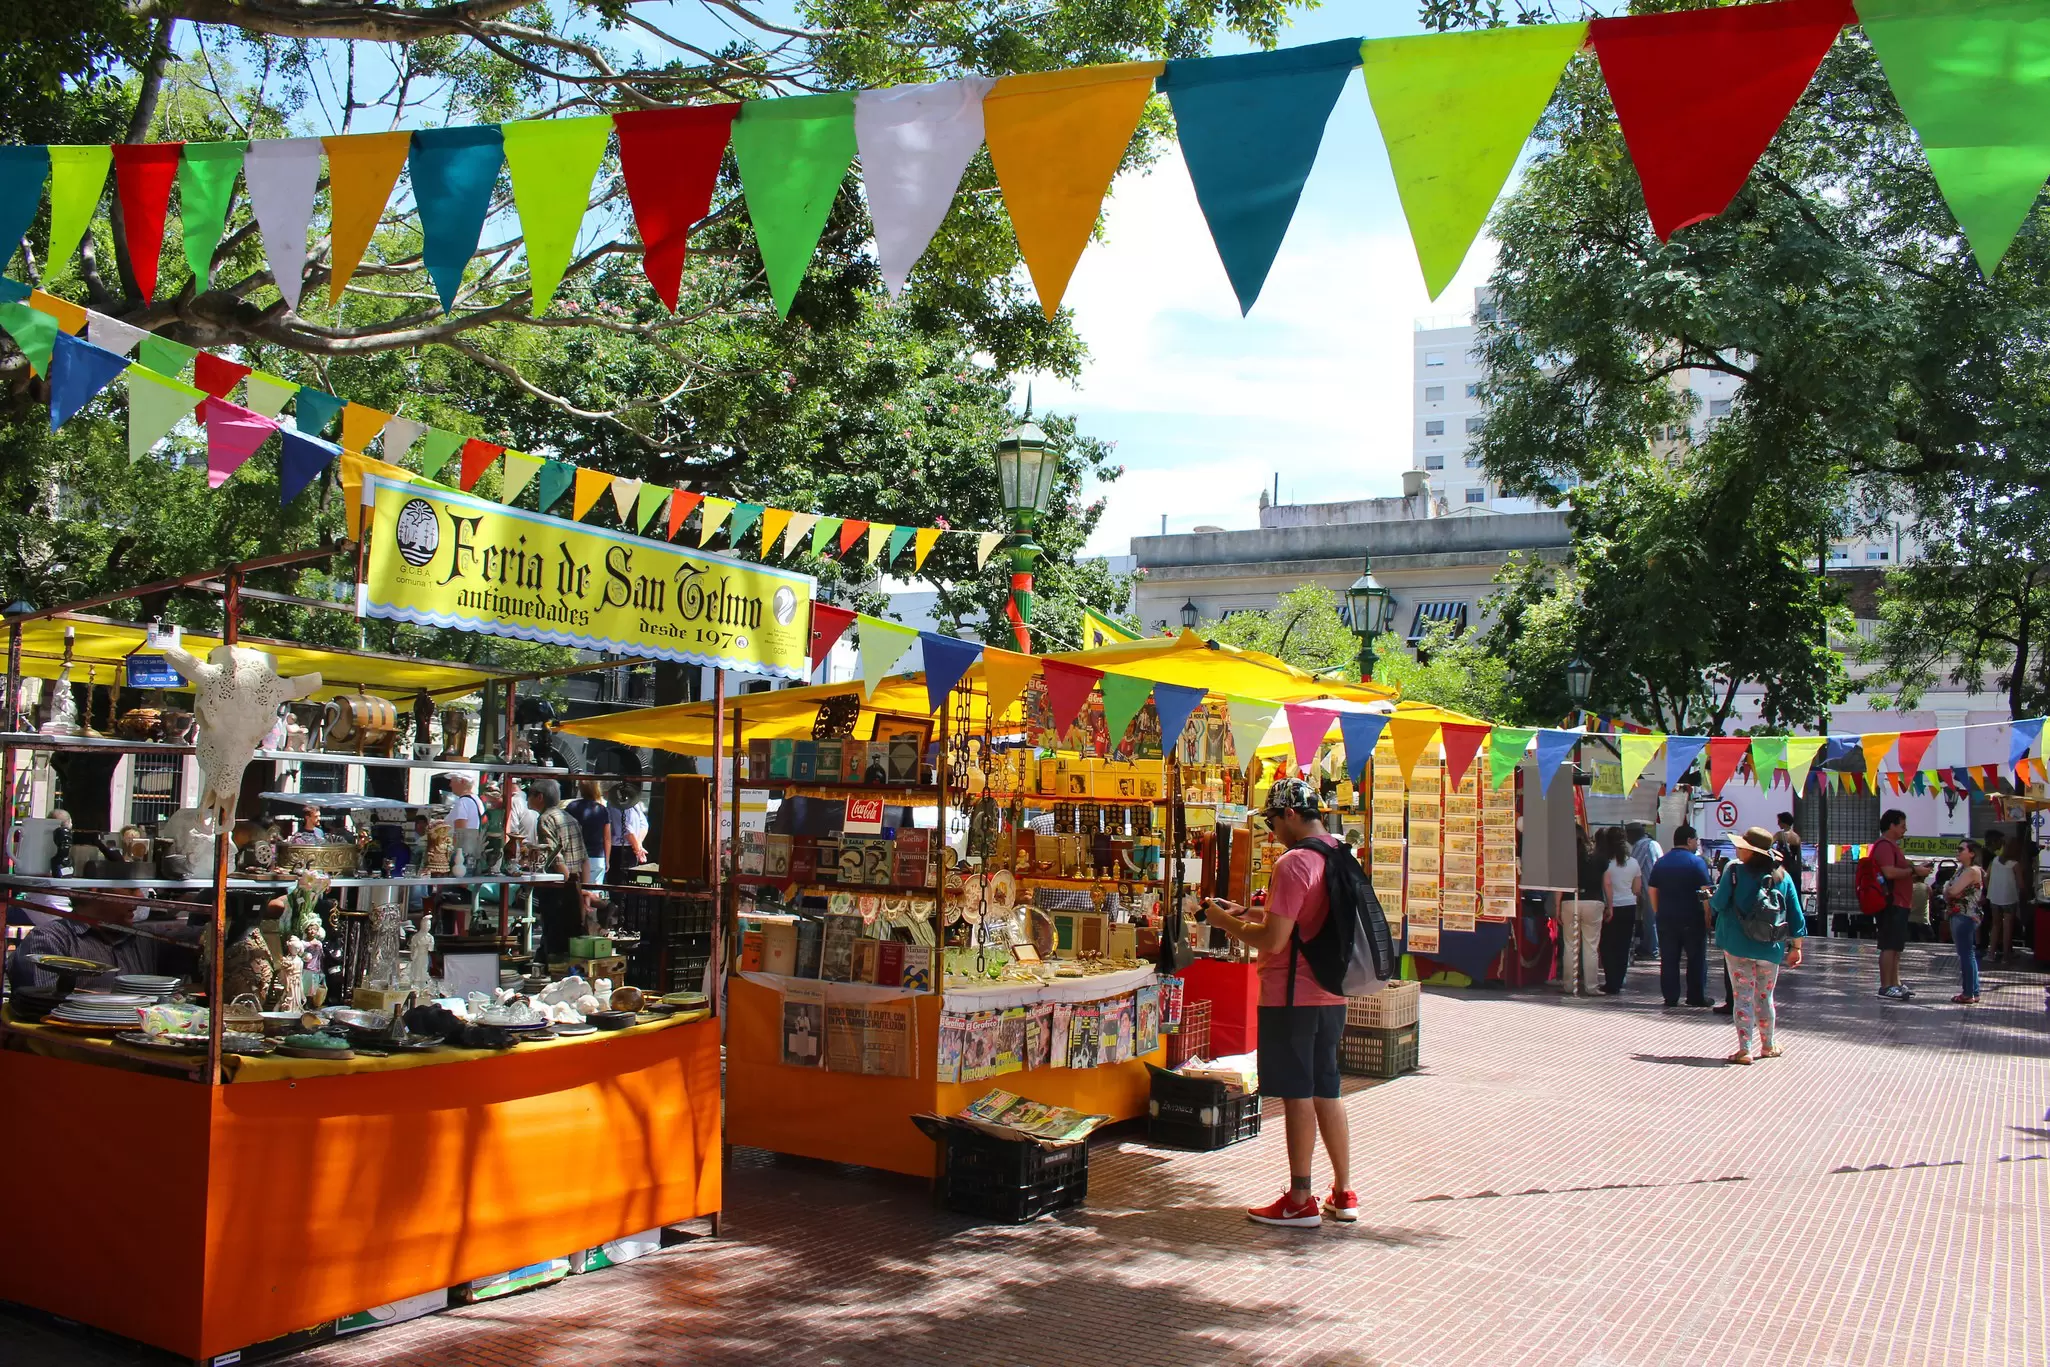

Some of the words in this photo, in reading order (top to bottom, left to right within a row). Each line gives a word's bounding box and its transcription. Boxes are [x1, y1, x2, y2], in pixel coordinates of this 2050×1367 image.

[436, 505, 544, 590] Feria
[557, 541, 591, 600] de
[594, 545, 665, 613] San
[674, 562, 762, 630] Telmo
[395, 577, 425, 587] comuna
[457, 586, 589, 627] antiguedades
[639, 618, 687, 639] desde
[721, 819, 750, 827] Cona
[1904, 838, 1925, 849] Feria
[1928, 838, 1937, 849] de
[895, 852, 928, 862] Alquimista
